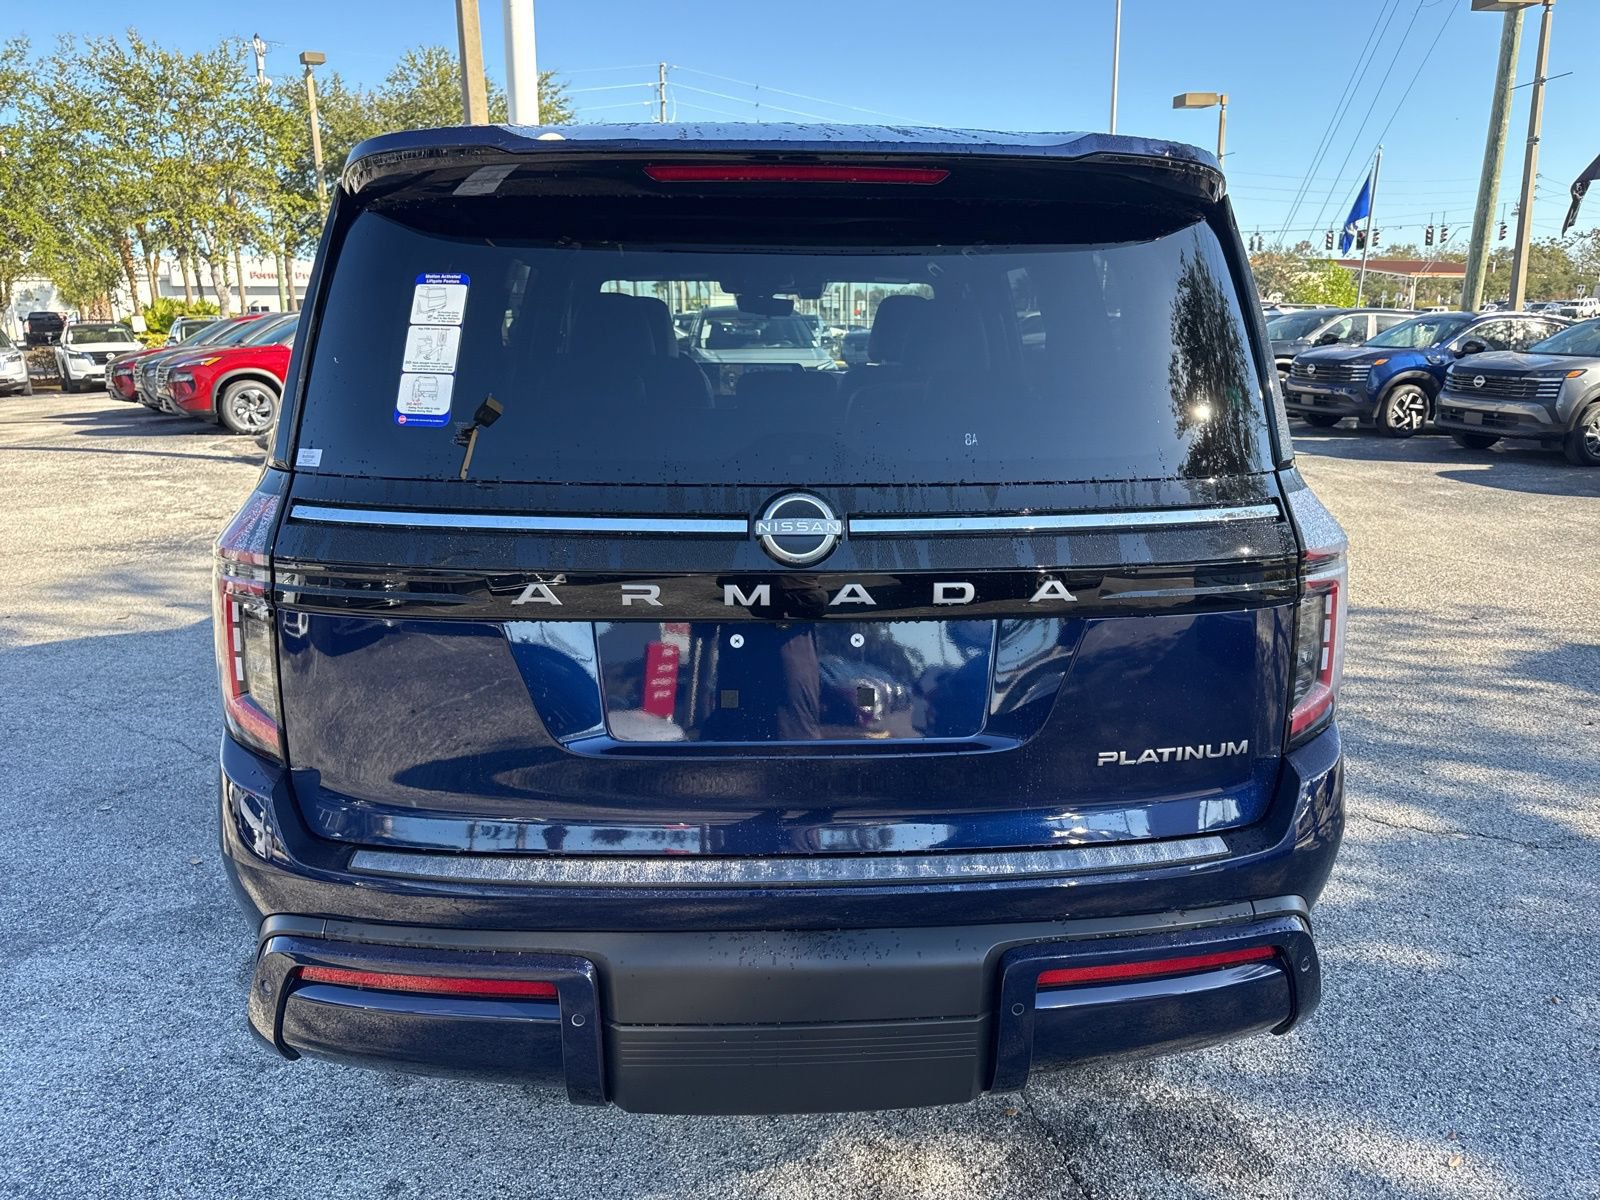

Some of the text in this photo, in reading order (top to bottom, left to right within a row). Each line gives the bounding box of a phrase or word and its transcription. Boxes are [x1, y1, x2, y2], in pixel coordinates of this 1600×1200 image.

[964, 432, 979, 446] 8A
[758, 521, 839, 533] NISSAN
[511, 580, 1078, 607] ARMADA
[1096, 739, 1249, 767] PLATINUM
